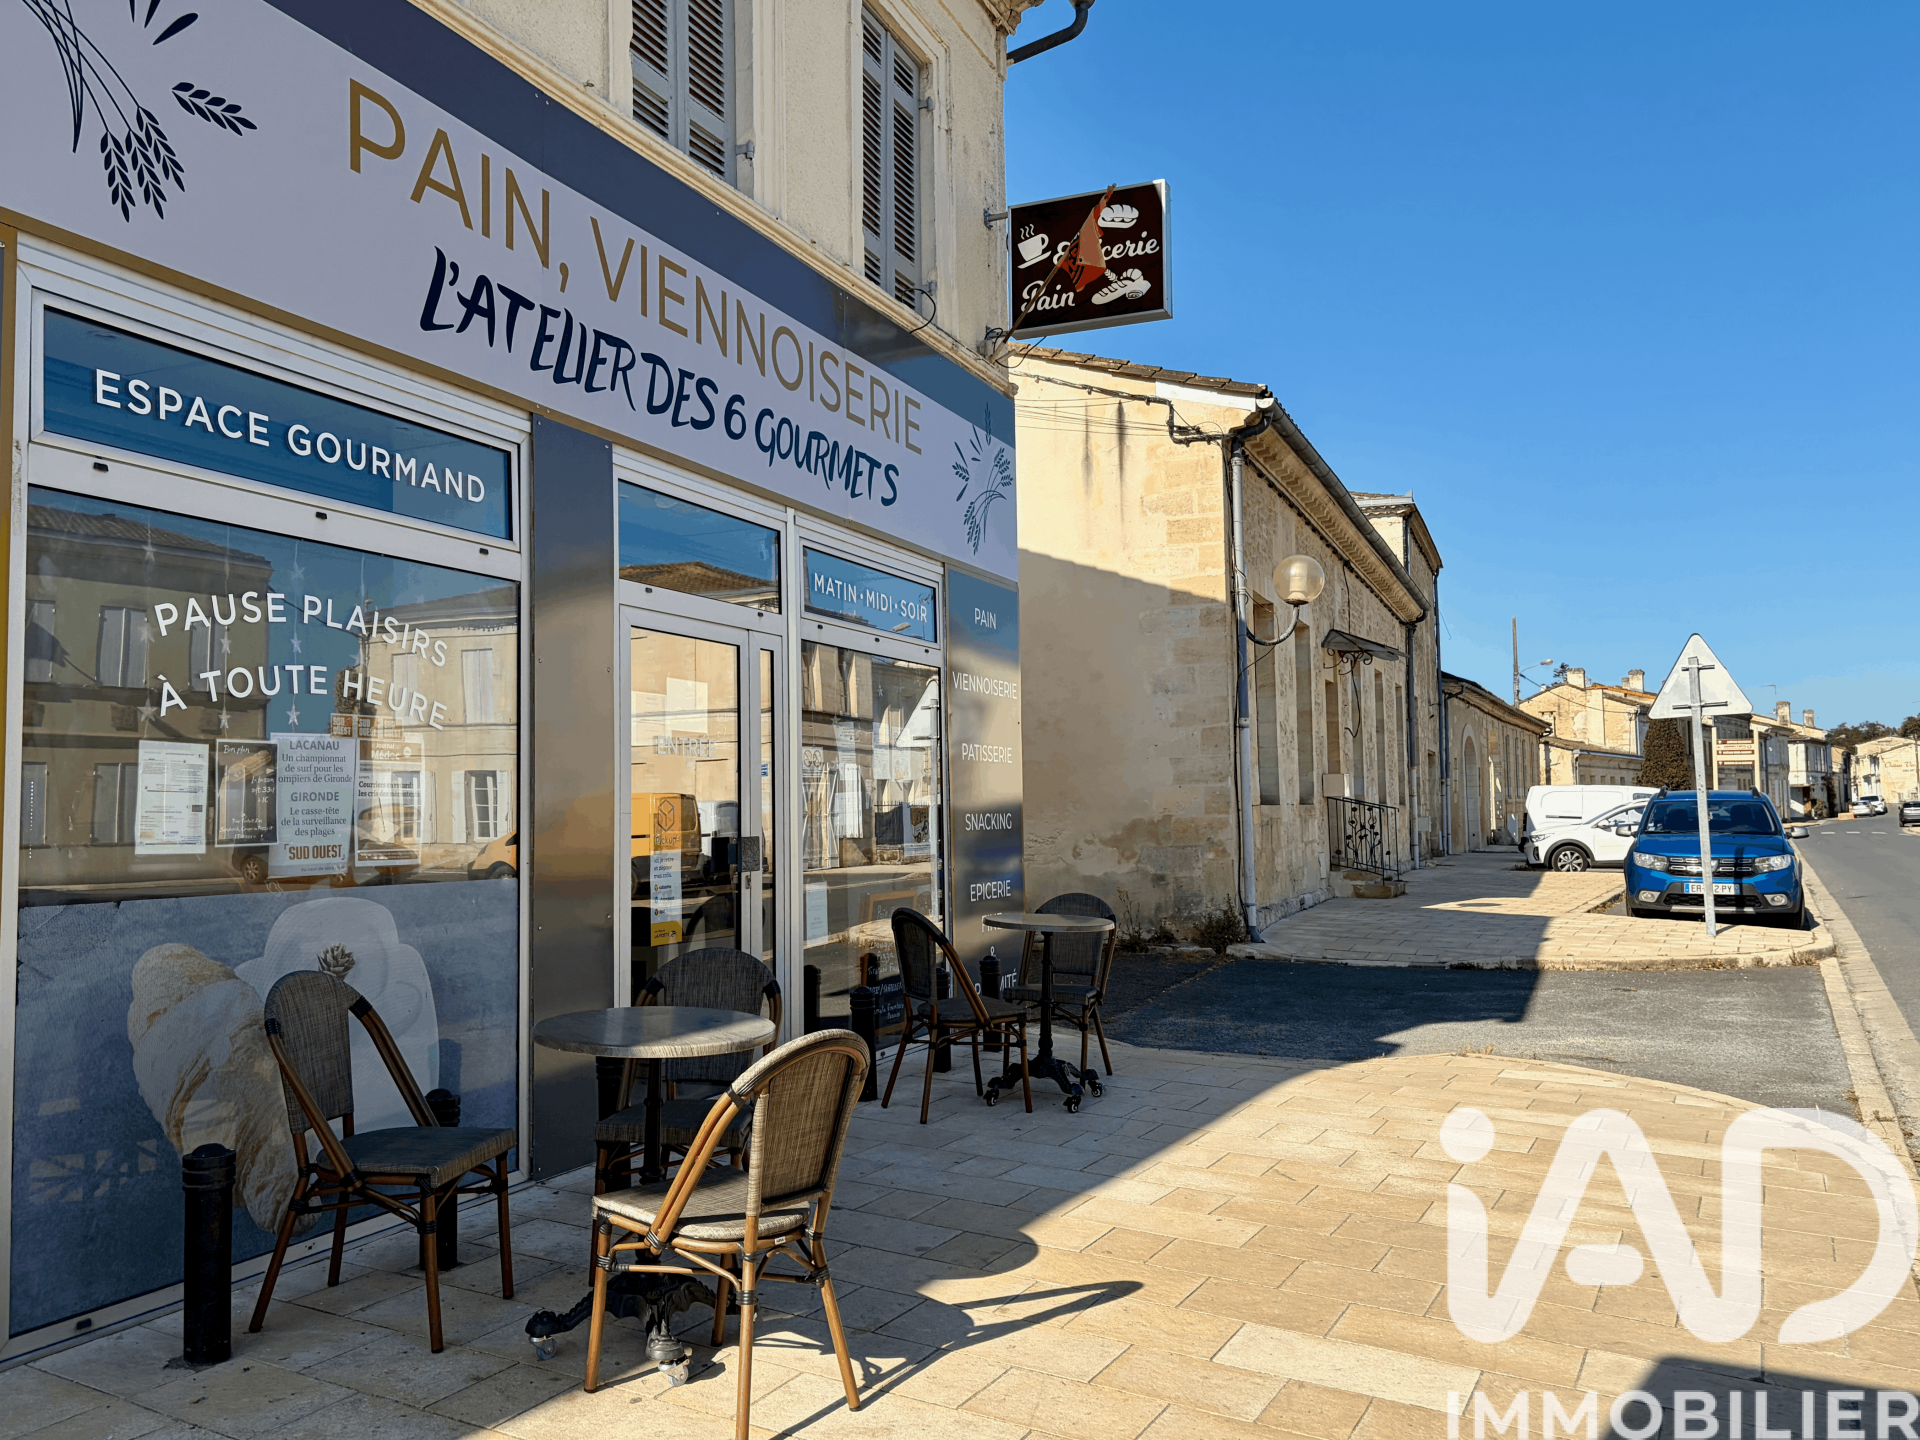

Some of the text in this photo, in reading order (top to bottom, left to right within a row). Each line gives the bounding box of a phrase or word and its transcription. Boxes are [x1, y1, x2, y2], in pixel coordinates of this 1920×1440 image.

[349, 77, 923, 456] PAIN, VIENNOISERIE
[1020, 280, 1076, 314] Pain
[419, 245, 900, 507] L'ATELIER DES 6 GOURMETS
[95, 368, 486, 504] ESPACE GOURMAND
[814, 572, 928, 623] MATIN MIDI SOIR
[154, 591, 448, 668] PAUSE PLAISIRS
[974, 607, 997, 630] PAIN
[952, 671, 1018, 700] VIENNOISERIE
[158, 664, 448, 732] À TOUTE HEURE
[290, 740, 340, 751] LACANAU
[655, 734, 718, 759] ENTRÉE
[961, 742, 1013, 764] PATISSERIE
[281, 753, 347, 765] Un championnat
[285, 763, 344, 775] de surf pour les
[313, 774, 323, 783] de
[324, 773, 353, 783] Gironde
[290, 791, 340, 802] GIRONDE
[281, 816, 347, 826] de la surveillance
[290, 806, 340, 816] Le casse-tête
[965, 812, 1013, 831] SNACKING
[294, 827, 336, 838] des plages
[288, 846, 310, 860] SUD
[312, 844, 343, 859] OUEST
[970, 880, 1012, 902] EPICERIE
